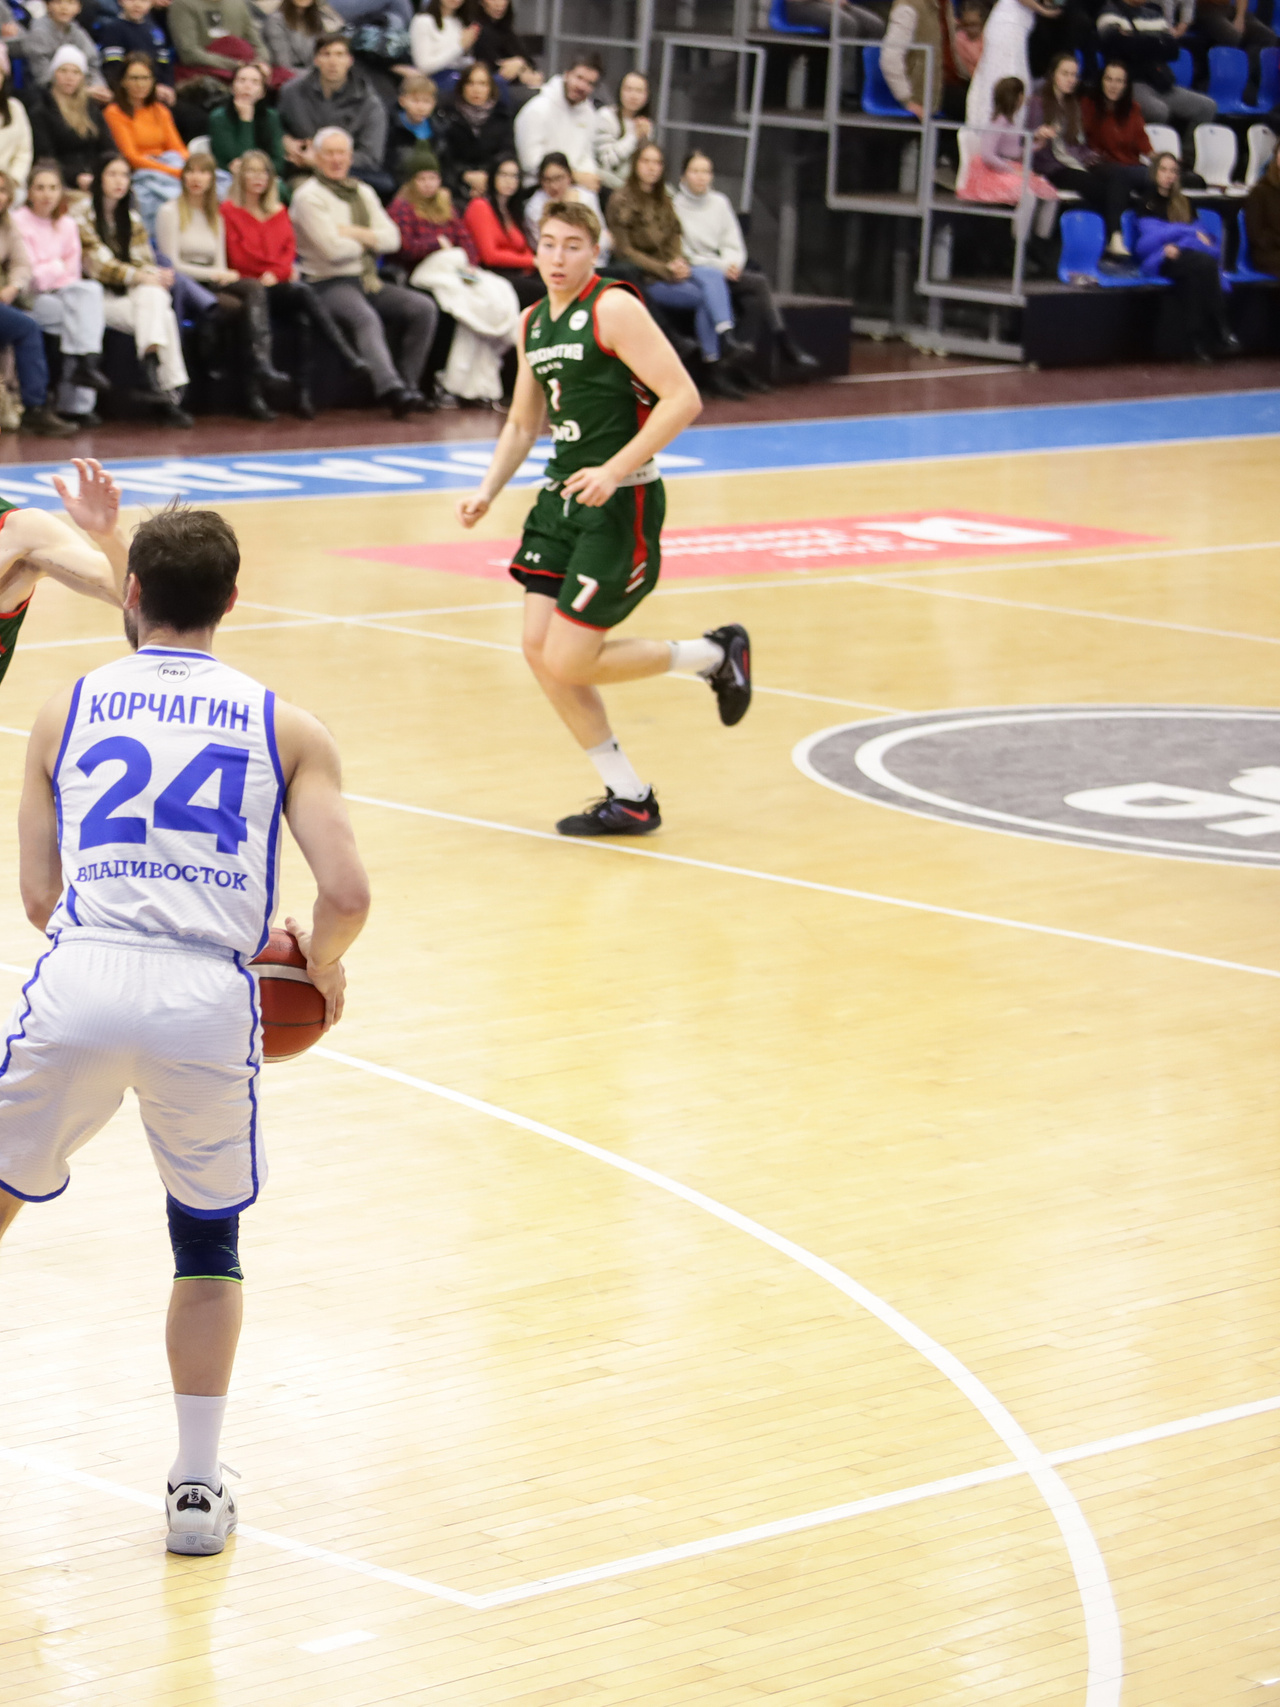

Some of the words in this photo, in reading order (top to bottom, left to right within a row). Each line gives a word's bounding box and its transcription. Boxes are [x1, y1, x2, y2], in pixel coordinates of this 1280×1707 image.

[571, 573, 600, 612] 7
[89, 691, 249, 732] КОРЧАГИН
[75, 735, 250, 856] 24
[75, 859, 248, 891] ВЛАДИВОСТОК
